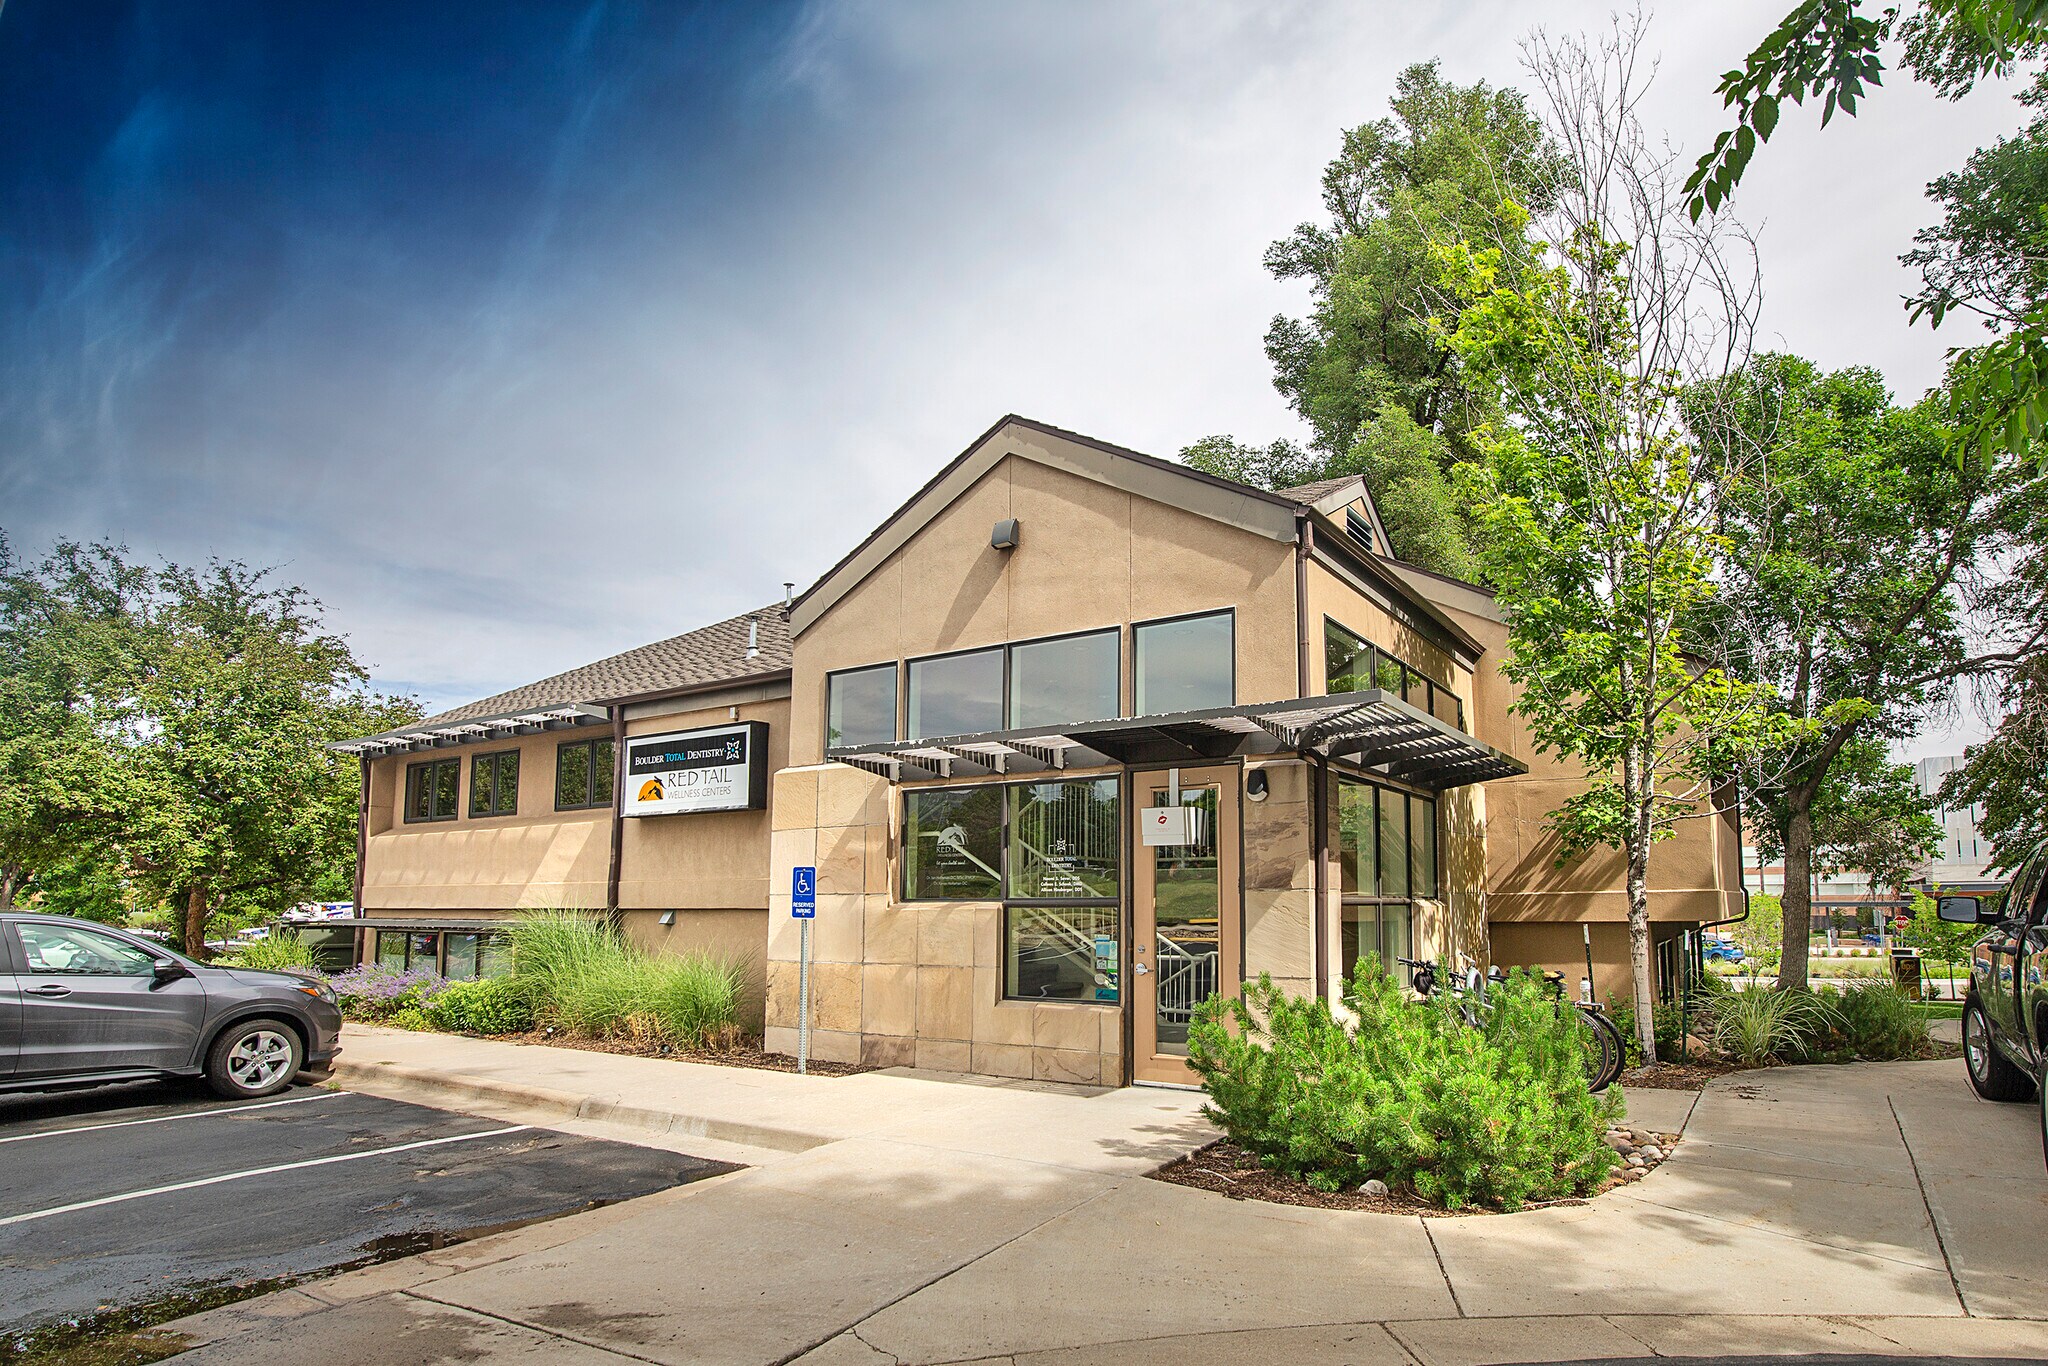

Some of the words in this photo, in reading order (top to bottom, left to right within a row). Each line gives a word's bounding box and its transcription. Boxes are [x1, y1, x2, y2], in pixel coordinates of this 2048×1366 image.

[635, 754, 664, 766] BOULDER
[665, 752, 686, 762] TOTAL
[687, 748, 724, 760] DENTISTRY
[668, 771, 699, 788] RED
[701, 767, 732, 785] TAIL
[668, 789, 700, 799] WELLNESS
[701, 786, 731, 797] CENTERS
